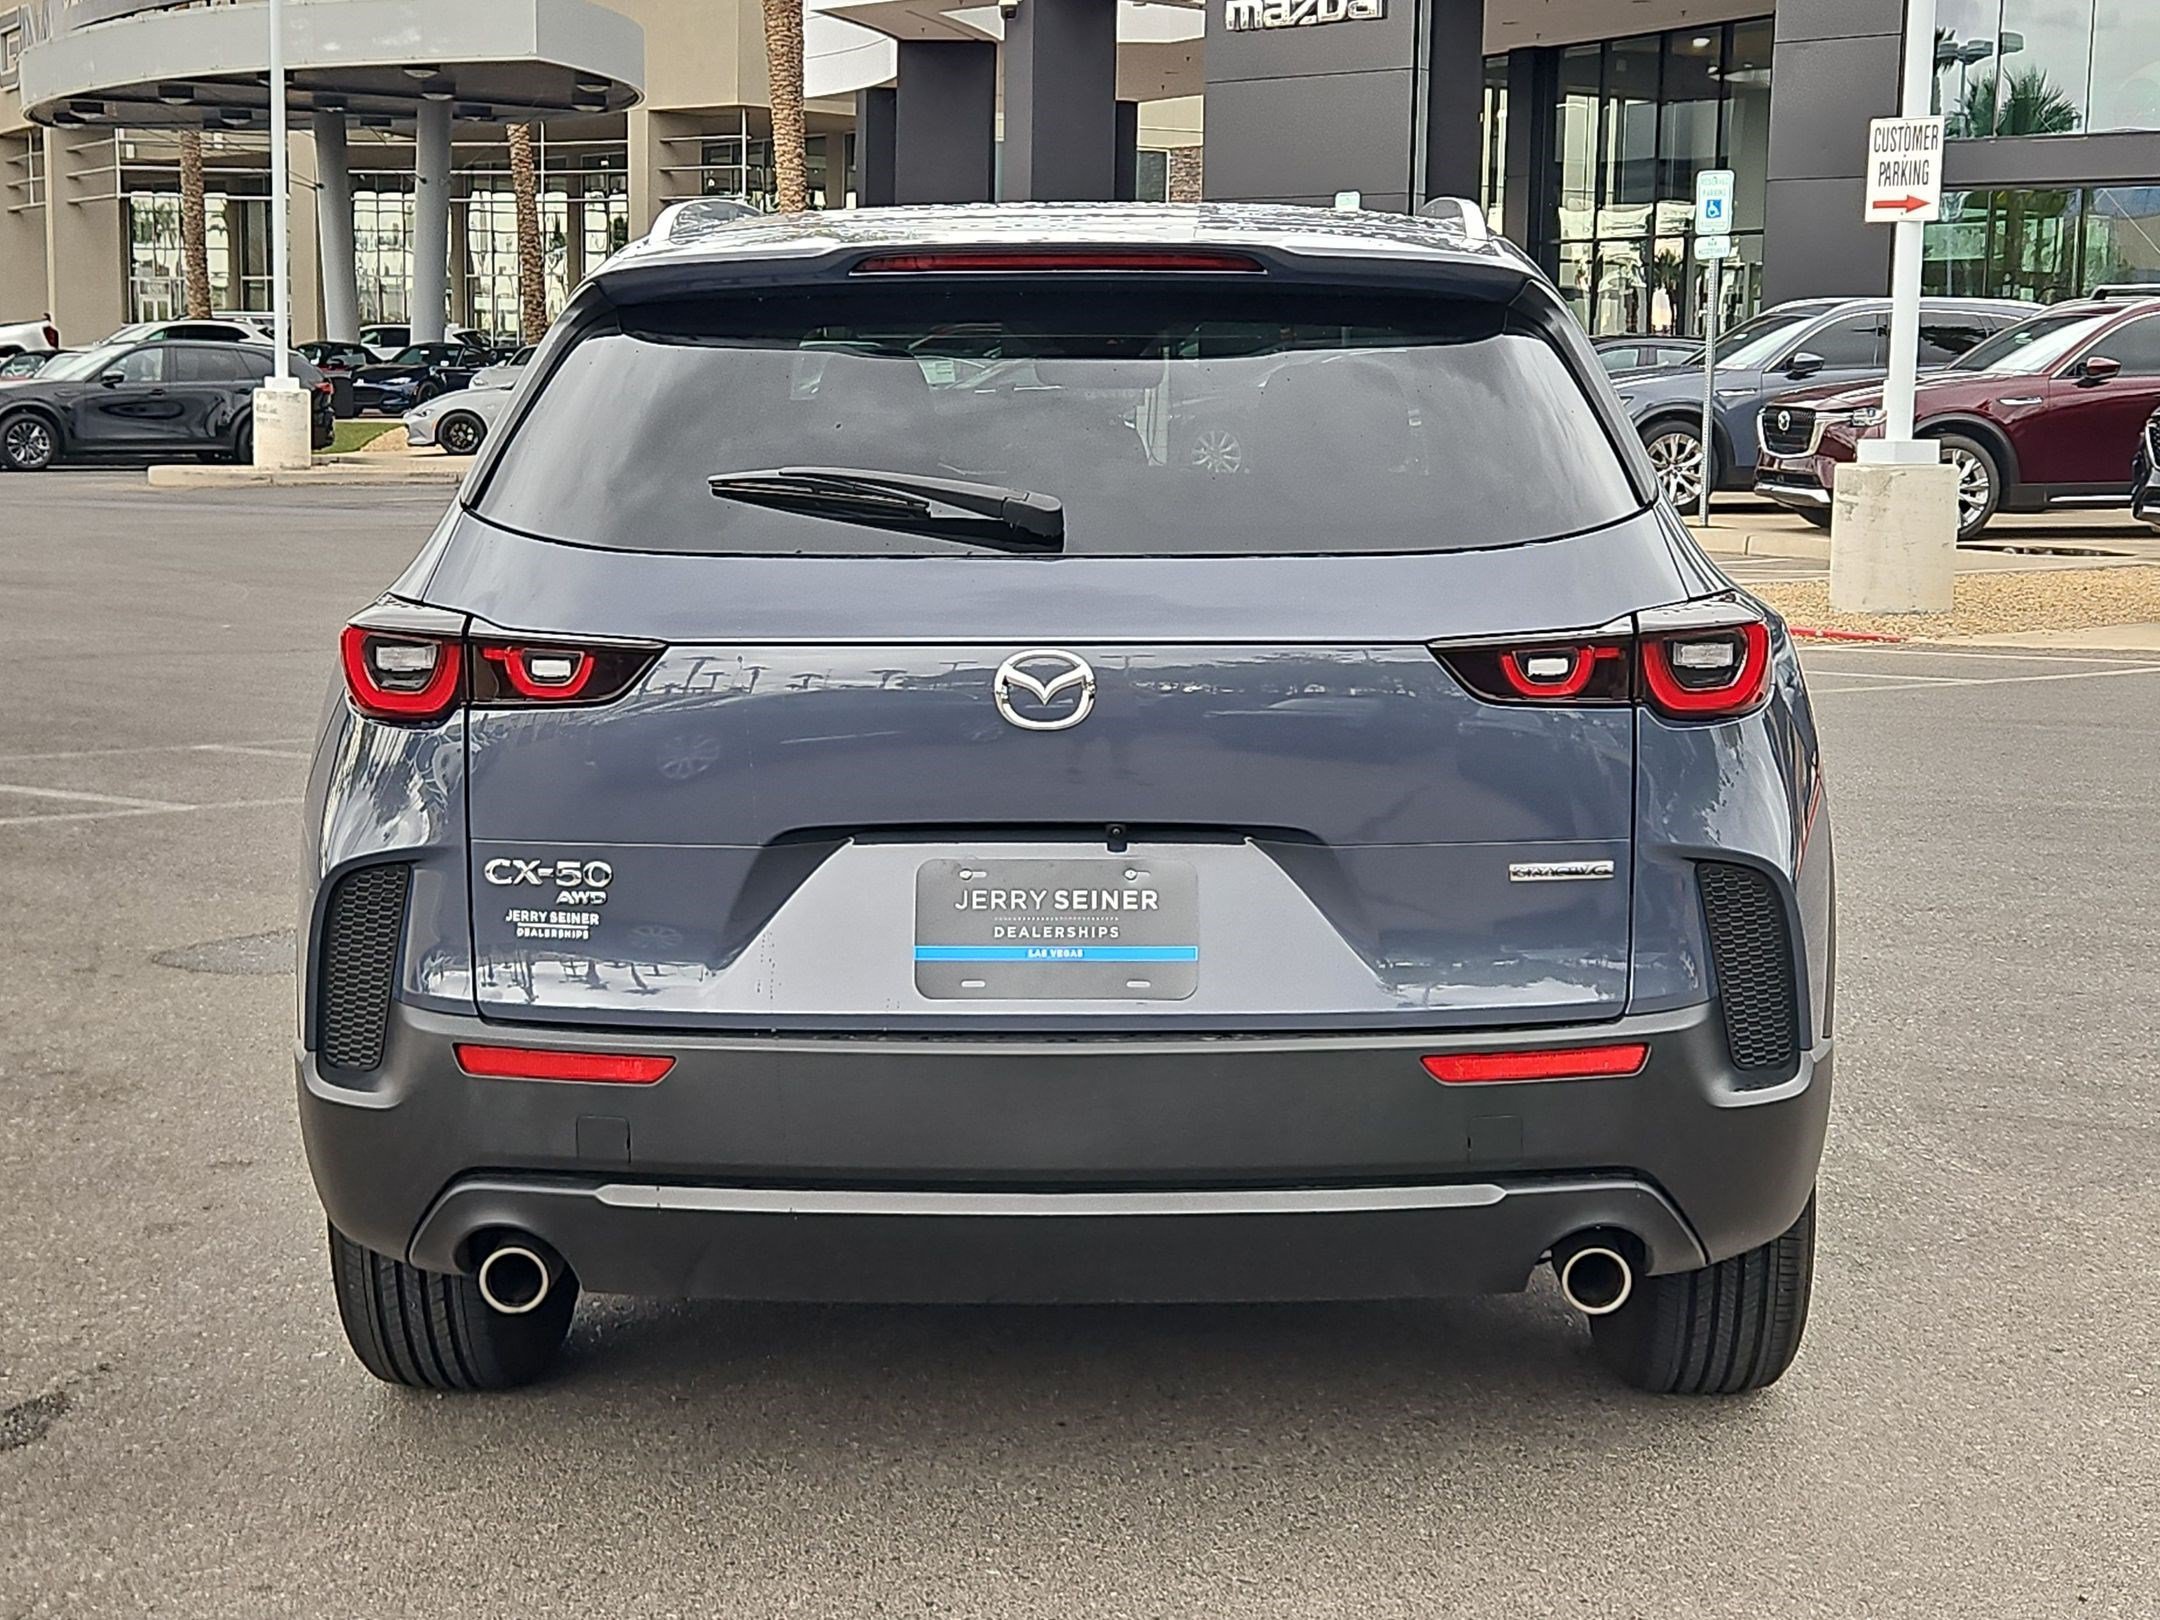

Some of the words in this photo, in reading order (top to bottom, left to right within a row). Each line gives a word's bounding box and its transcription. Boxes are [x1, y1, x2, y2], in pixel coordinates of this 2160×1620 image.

[1873, 124, 1939, 153] CUSTOMER
[1878, 159, 1930, 187] PARKING
[484, 858, 613, 888] CX-50
[555, 890, 607, 905] AWD
[954, 889, 1048, 911] JERRY
[1054, 889, 1159, 911] SEINER
[505, 909, 548, 923] JERRY
[549, 911, 600, 925] SEINER
[516, 927, 590, 940] DEALERSHIPS
[993, 925, 1120, 939] DEALERSHIPS
[1028, 948, 1047, 958] LAS
[1049, 948, 1084, 958] VEGAS
